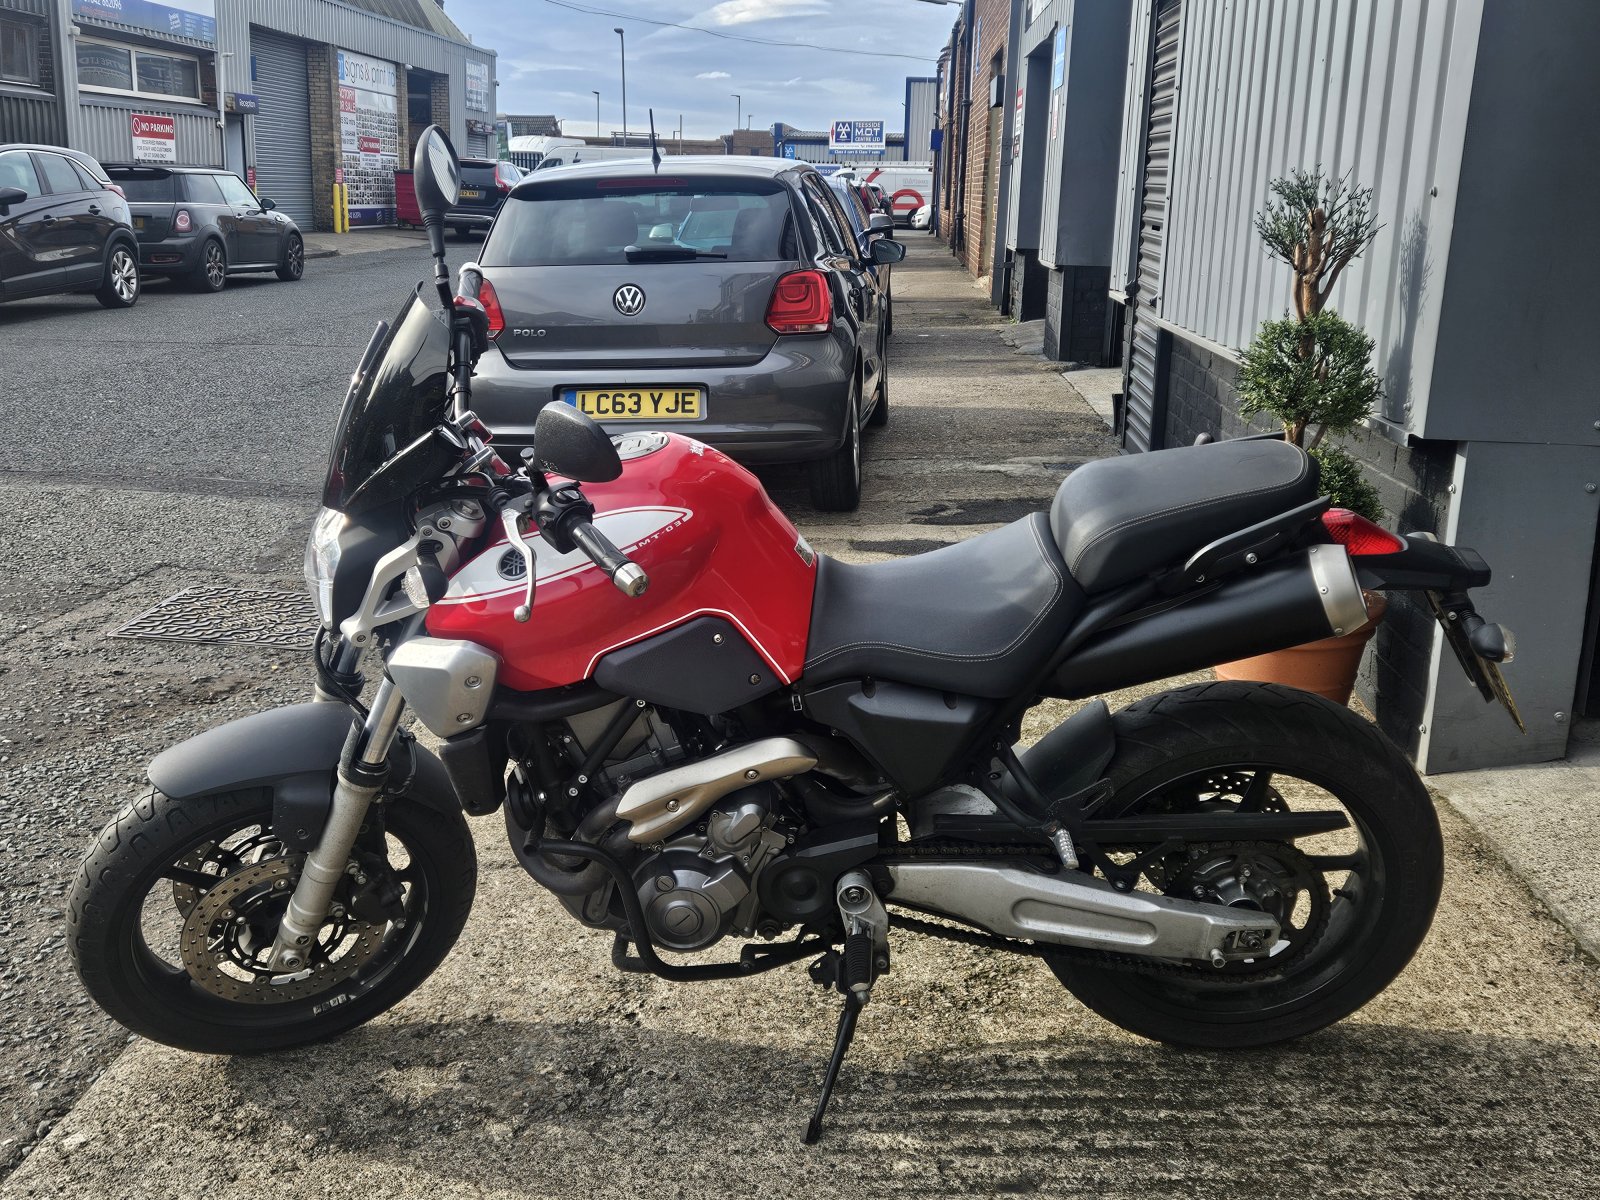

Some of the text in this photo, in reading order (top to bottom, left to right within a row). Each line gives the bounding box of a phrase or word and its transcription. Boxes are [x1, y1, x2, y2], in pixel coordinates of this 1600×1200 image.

[345, 56, 363, 83] signs
[365, 62, 370, 81] &
[239, 98, 256, 108] Reception
[141, 122, 173, 133] NO PARKING
[513, 329, 546, 337] POLO
[580, 392, 695, 414] LC63 YJE
[639, 520, 682, 547] MT-03
